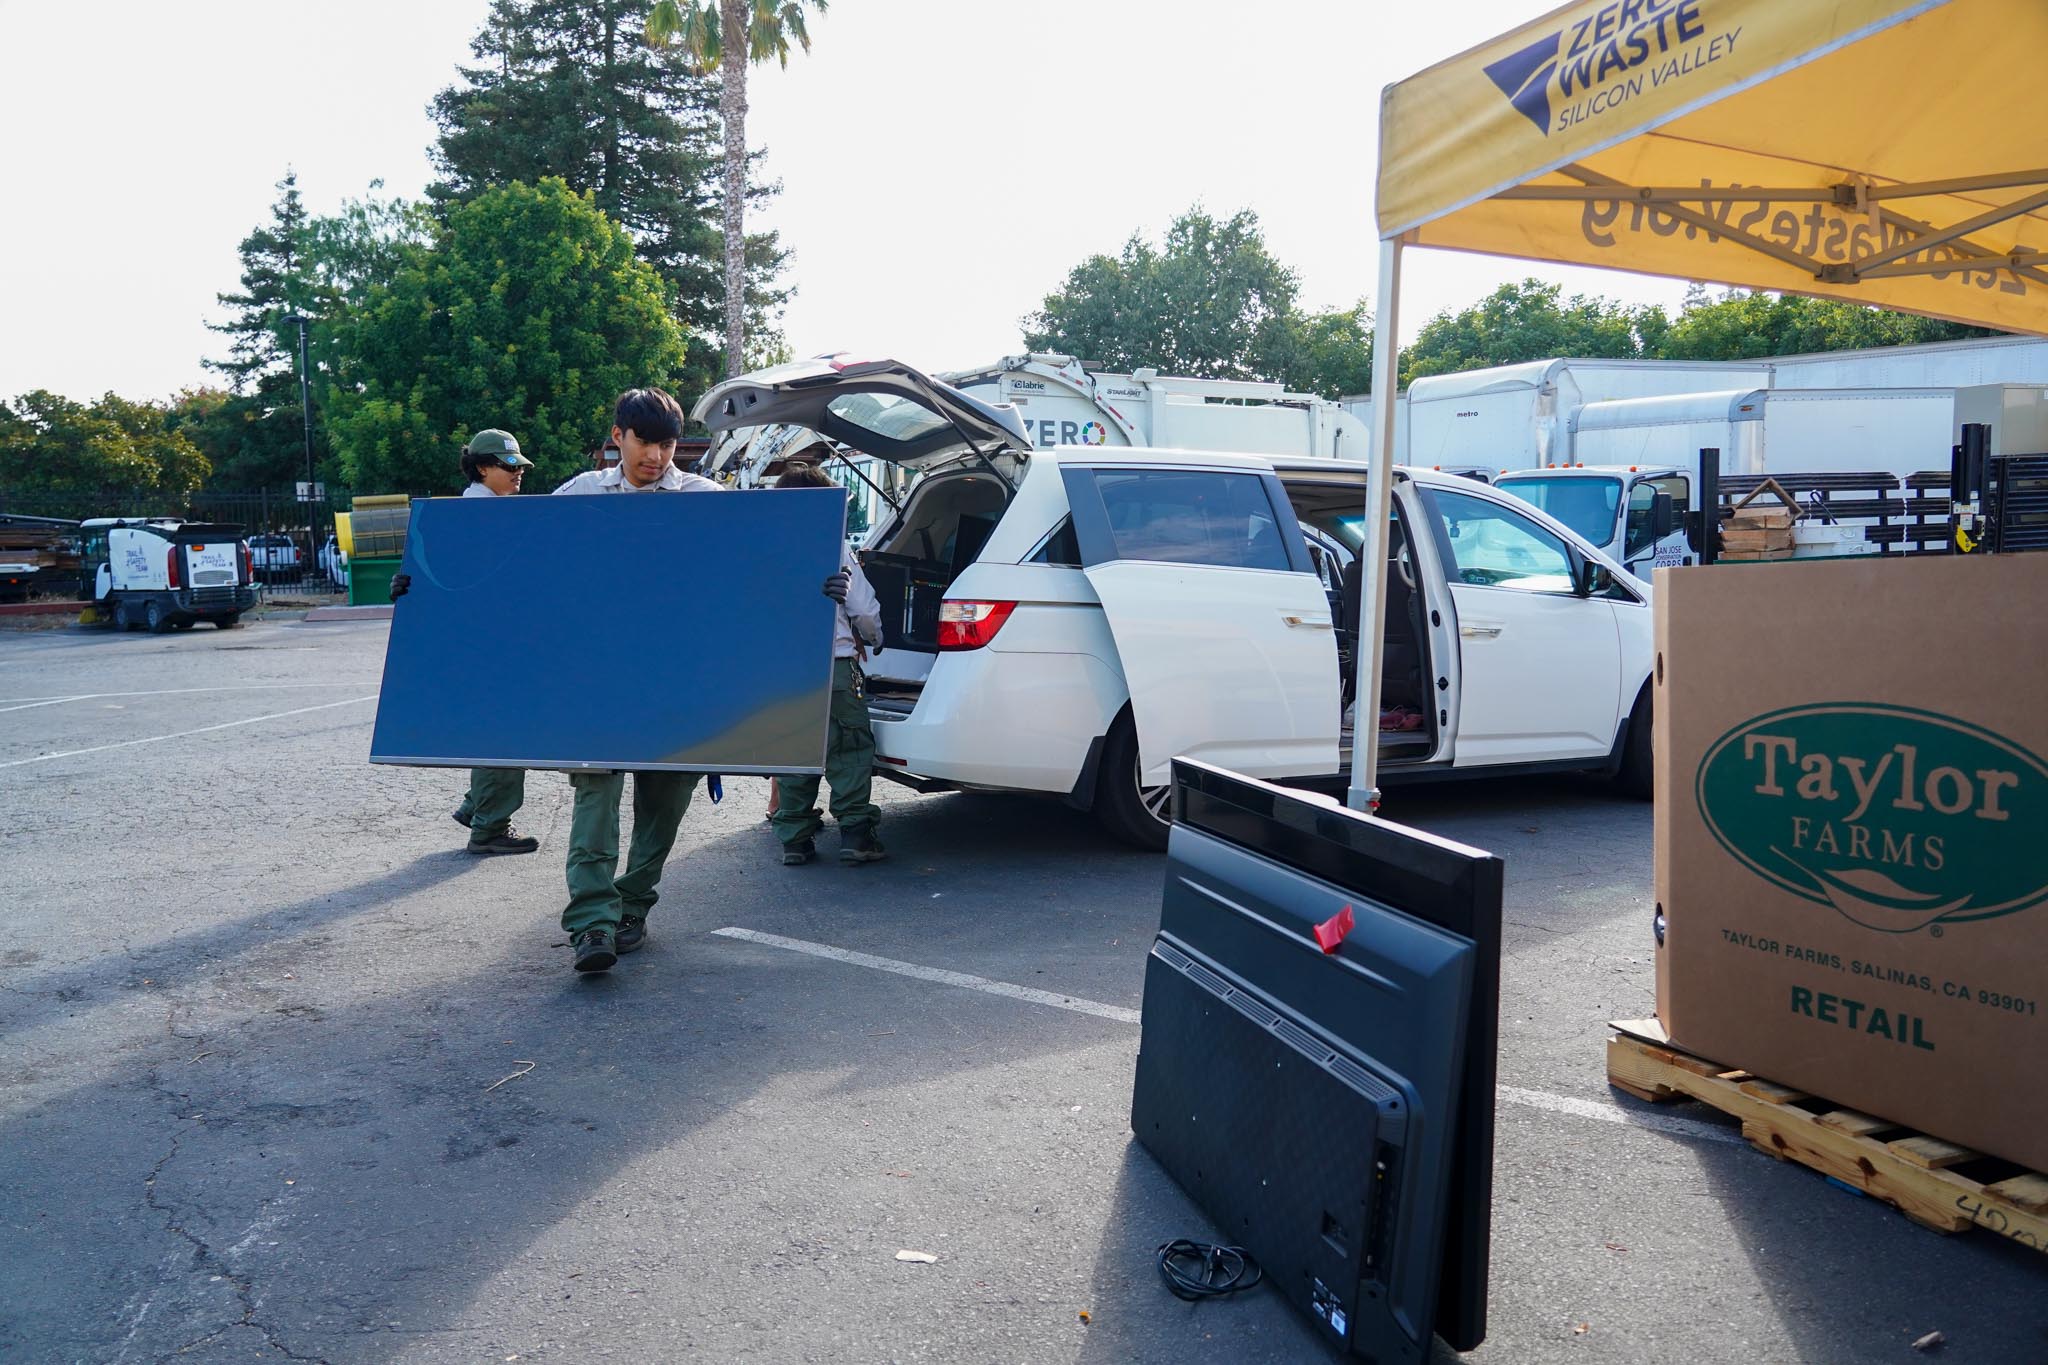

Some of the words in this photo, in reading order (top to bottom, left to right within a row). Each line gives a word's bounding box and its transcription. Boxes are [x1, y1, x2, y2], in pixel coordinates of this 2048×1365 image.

[1557, 75, 1644, 132] SILICON
[1651, 26, 1743, 88] VALLEY
[1559, 0, 1704, 98] WASTE
[1022, 380, 1045, 390] labrie
[1655, 546, 1668, 555] SAN
[1668, 546, 1682, 554] JOSE
[1744, 733, 2020, 822] Taylor
[1792, 815, 1945, 871] FARMS
[1721, 928, 1780, 955] TAYLOR
[1785, 944, 1846, 972] FARMS,
[1851, 960, 1937, 994] SALINAS,
[1943, 980, 1971, 1001] CA
[1978, 989, 2037, 1017] 93901
[1791, 984, 1936, 1052] RETAIL
